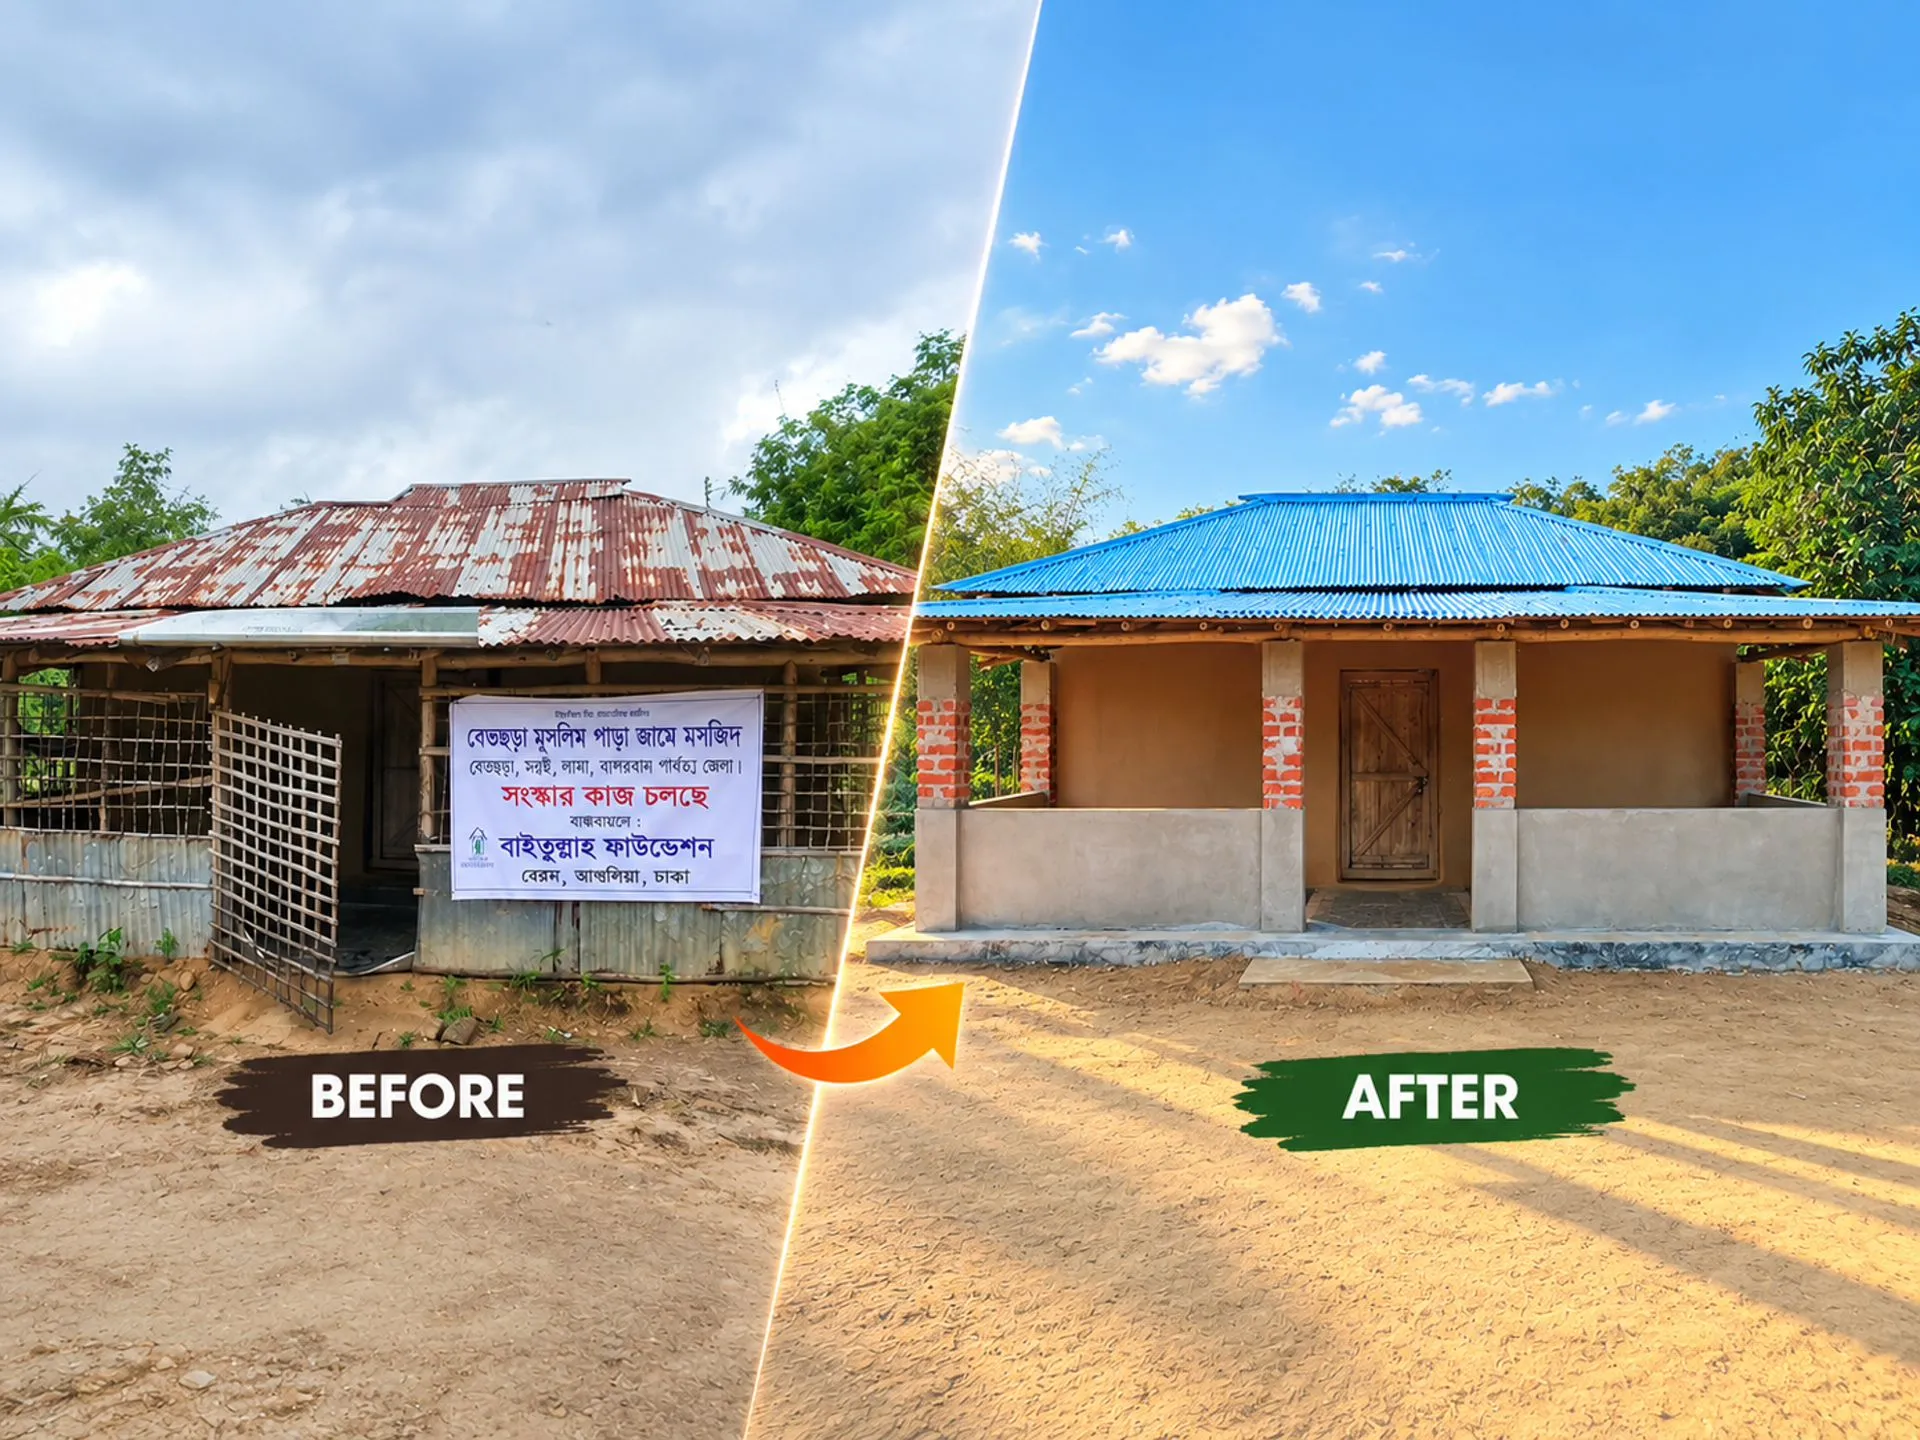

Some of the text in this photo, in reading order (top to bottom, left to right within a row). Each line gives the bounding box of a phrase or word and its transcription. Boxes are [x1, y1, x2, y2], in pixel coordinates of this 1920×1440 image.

[593, 725, 630, 752] পাড়া
[635, 725, 678, 748] জামে
[683, 719, 743, 748] মসজিদ
[501, 784, 710, 809] সংস্কার কাজ চলছে
